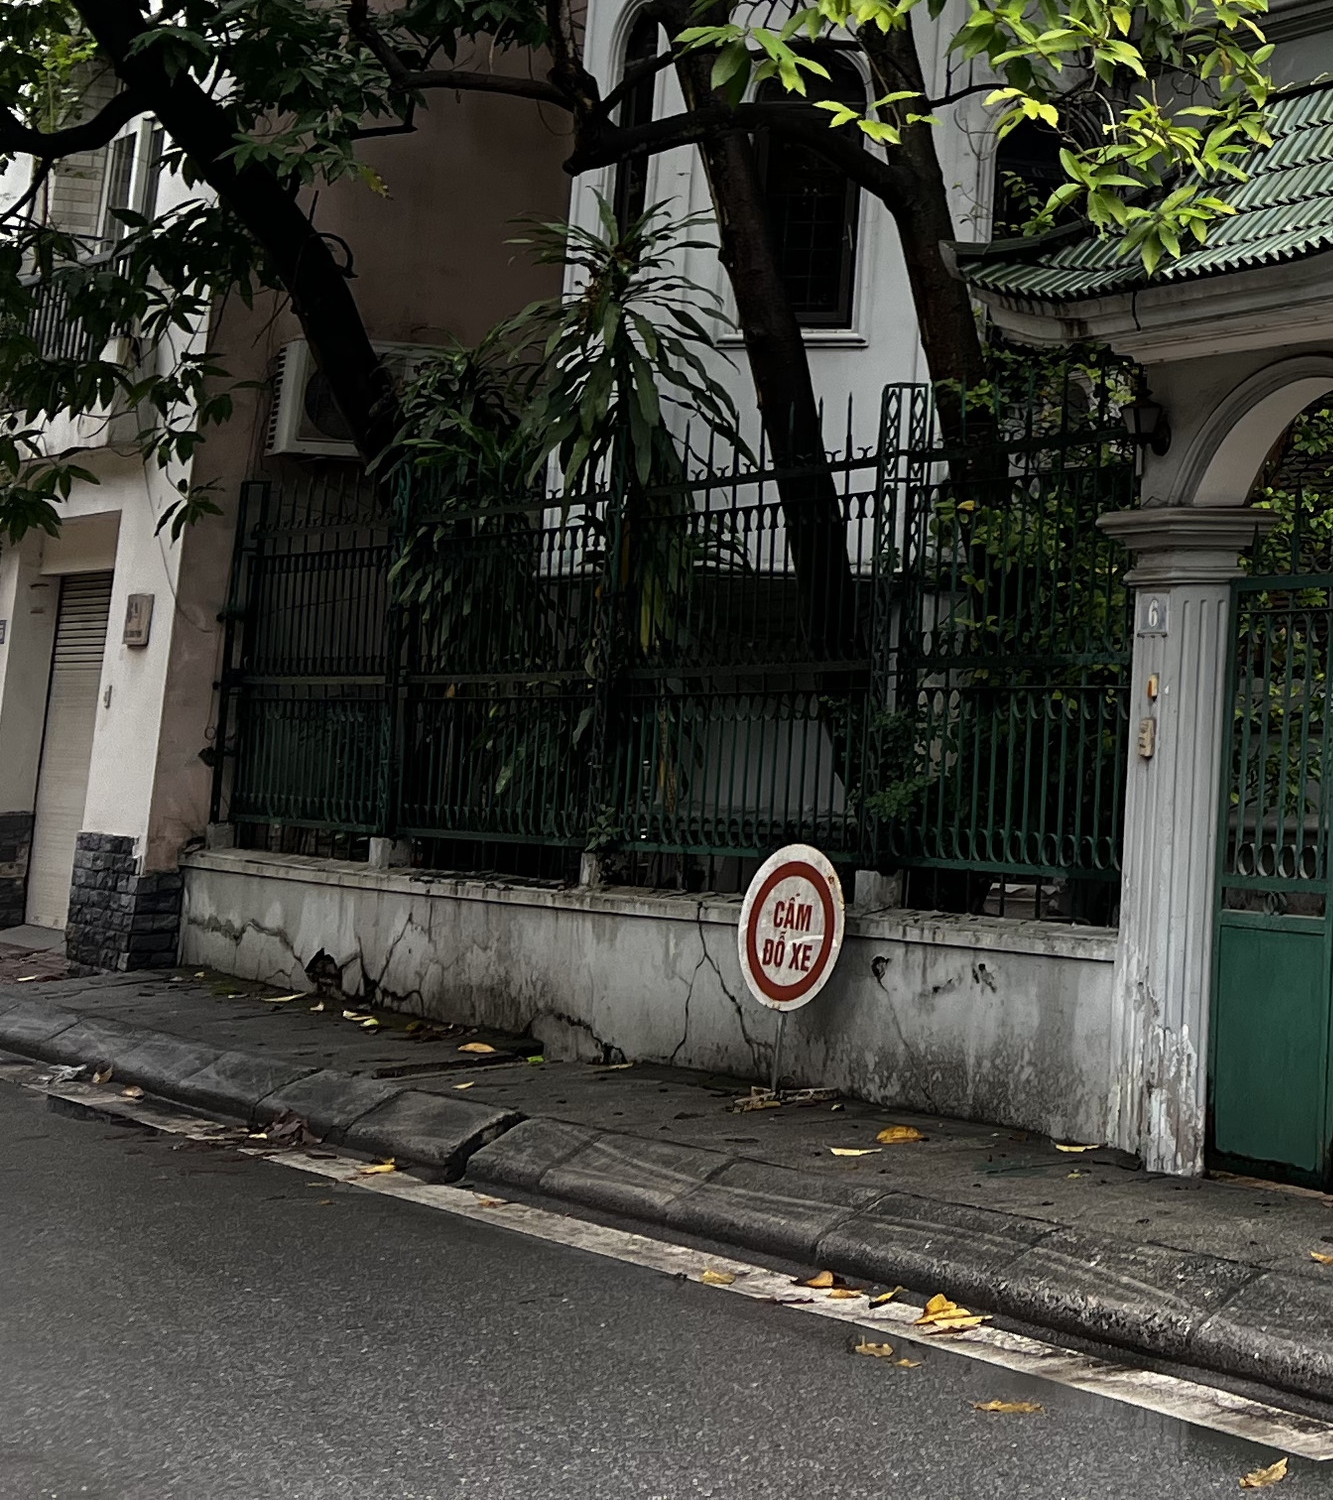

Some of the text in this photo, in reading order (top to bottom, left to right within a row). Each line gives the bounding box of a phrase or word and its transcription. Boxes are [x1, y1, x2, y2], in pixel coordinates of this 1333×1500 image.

[773, 893, 813, 931] CẤM
[762, 931, 813, 972] ĐỖ XE
